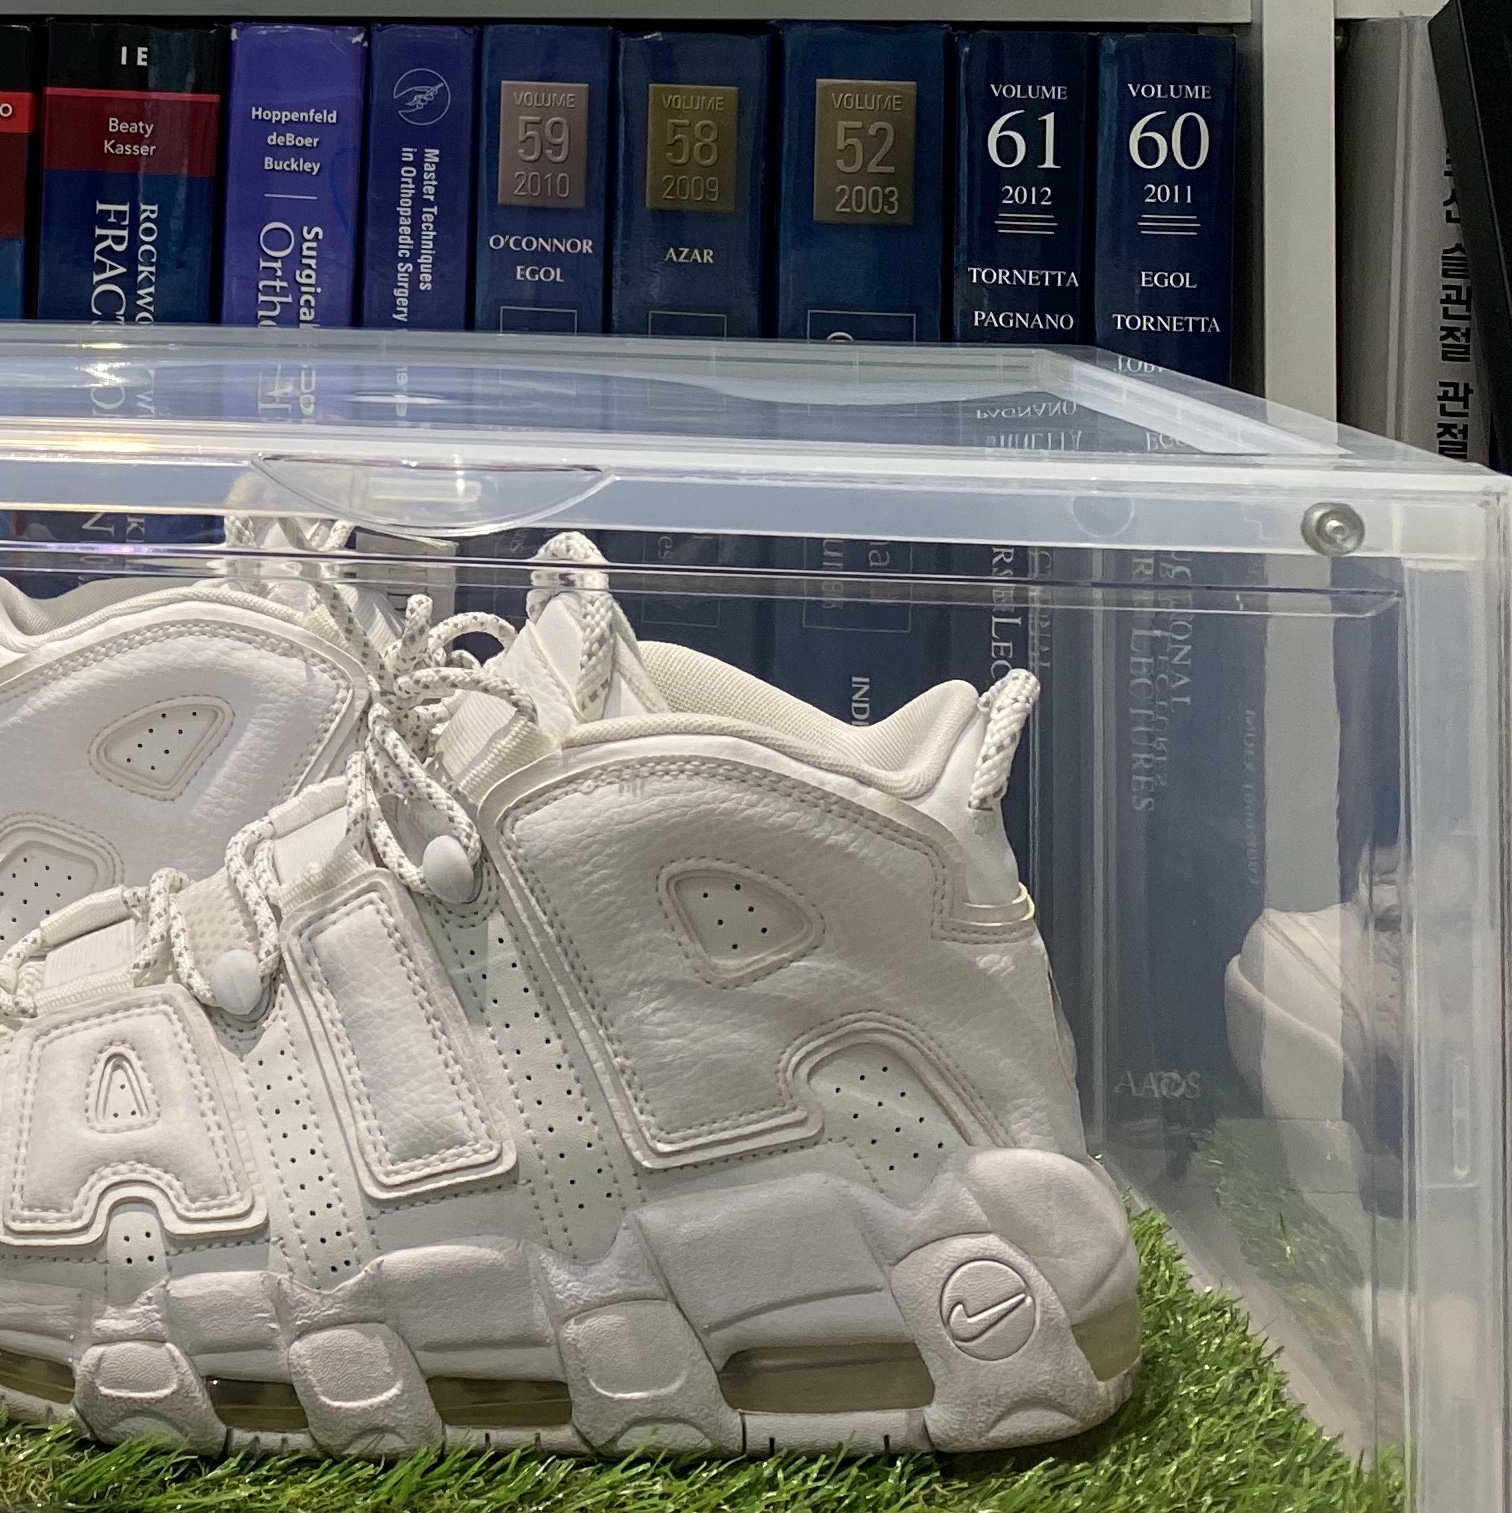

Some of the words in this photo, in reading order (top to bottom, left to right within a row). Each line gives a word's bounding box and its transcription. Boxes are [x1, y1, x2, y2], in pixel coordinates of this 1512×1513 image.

[512, 91, 576, 109] VOLUME
[990, 83, 1068, 100] VOLUME
[1127, 83, 1212, 100] VOLUME
[662, 93, 725, 112] VOLUME
[831, 92, 902, 112] VOLUME
[251, 106, 337, 125] Hoppenfeld
[108, 117, 154, 138] Beaty
[103, 140, 157, 156] Kasser
[267, 132, 320, 148] deBoer
[517, 116, 572, 164] 59
[665, 119, 719, 167] 58
[835, 120, 896, 174] 52
[987, 110, 1062, 169] 61
[1129, 110, 1209, 170] 60
[401, 147, 417, 161] in
[263, 156, 321, 175] Buckley
[423, 148, 439, 201] Master
[512, 172, 570, 198] 2010
[662, 175, 720, 202] 2009
[1001, 185, 1052, 205] 2012
[1144, 184, 1193, 204] 2011
[835, 184, 899, 215] 2003
[396, 166, 417, 258] Orthopaedic
[417, 205, 438, 291] Techniques
[488, 235, 593, 255] O'CONNOR
[664, 247, 714, 264] AZAR
[516, 264, 565, 283] EGOL
[967, 267, 1080, 287] TORNETTA
[1140, 271, 1198, 289] EGOL
[392, 262, 413, 322] Surgery
[973, 310, 1074, 330] PAGNANO
[1112, 314, 1221, 333] TORNETTA
